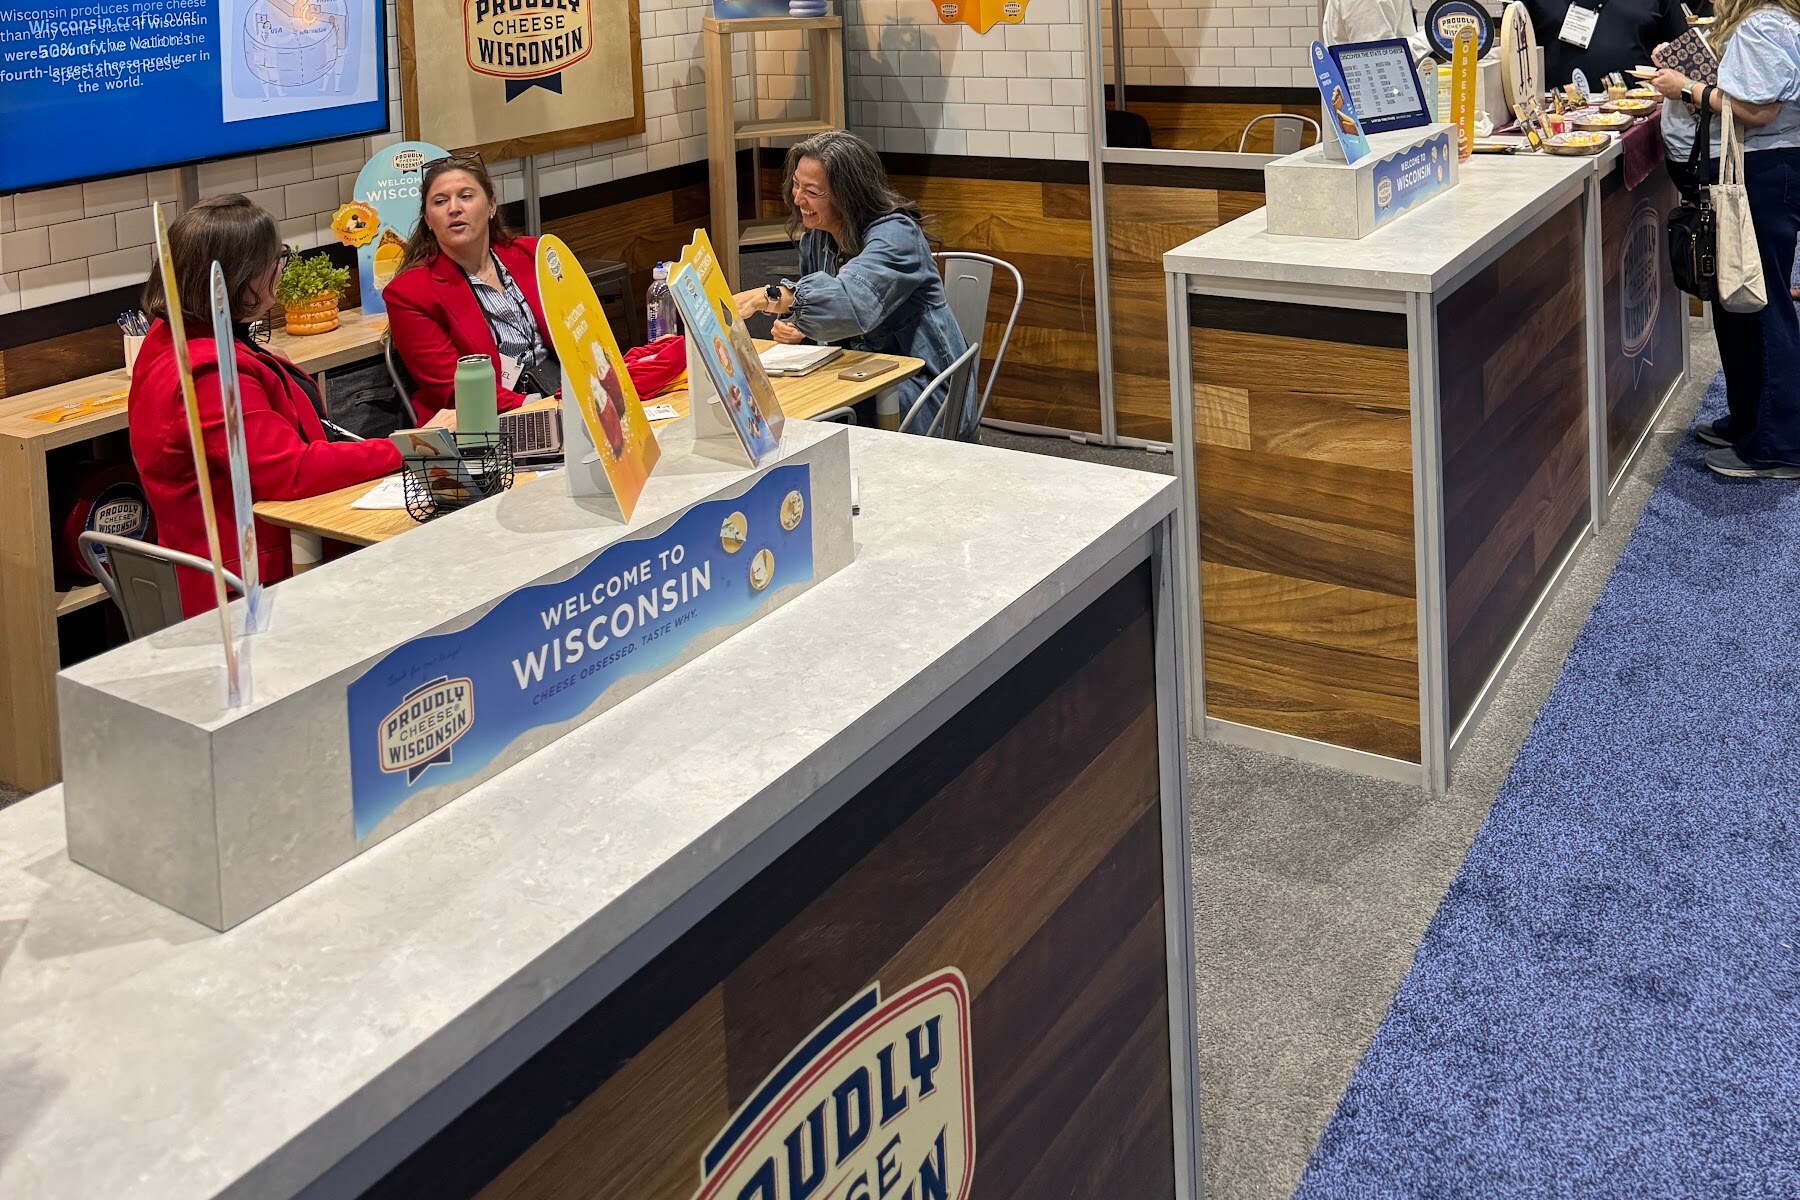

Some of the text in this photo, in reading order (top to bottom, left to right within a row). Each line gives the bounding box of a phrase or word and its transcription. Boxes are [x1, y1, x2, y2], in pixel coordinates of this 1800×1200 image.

[0, 7, 67, 22] Wisconsin
[70, 2, 129, 19] produces
[132, 1, 163, 13] more
[29, 15, 112, 35] Wisconsin
[117, 11, 160, 27] crafts
[493, 14, 565, 36] CHEESE
[0, 29, 31, 42] than
[477, 26, 583, 67] WISCONSIN
[0, 60, 94, 83] fourth-largest
[200, 49, 211, 61] in
[5, 50, 38, 62] were
[78, 74, 144, 93] the world.
[1458, 44, 1469, 139] OBSESSED
[395, 153, 423, 161] PROUDLY
[395, 160, 424, 169] WISCONSIN
[1401, 152, 1426, 172] WELCOME TO
[378, 176, 422, 188] WELCOM
[1396, 162, 1431, 192] WISCONSIN
[366, 186, 420, 202] WISCO
[100, 504, 139, 520] PROUDLY
[98, 518, 138, 534] WISCONSIN
[540, 544, 685, 631] WELCOME TO
[512, 560, 712, 690] WISCONSIN
[532, 608, 698, 706] CHEESE OBSESSED. TASTE WHY.
[388, 686, 465, 740] PROUDLY
[389, 709, 466, 765] WISCONSIN
[736, 1014, 943, 1200] UDLY
